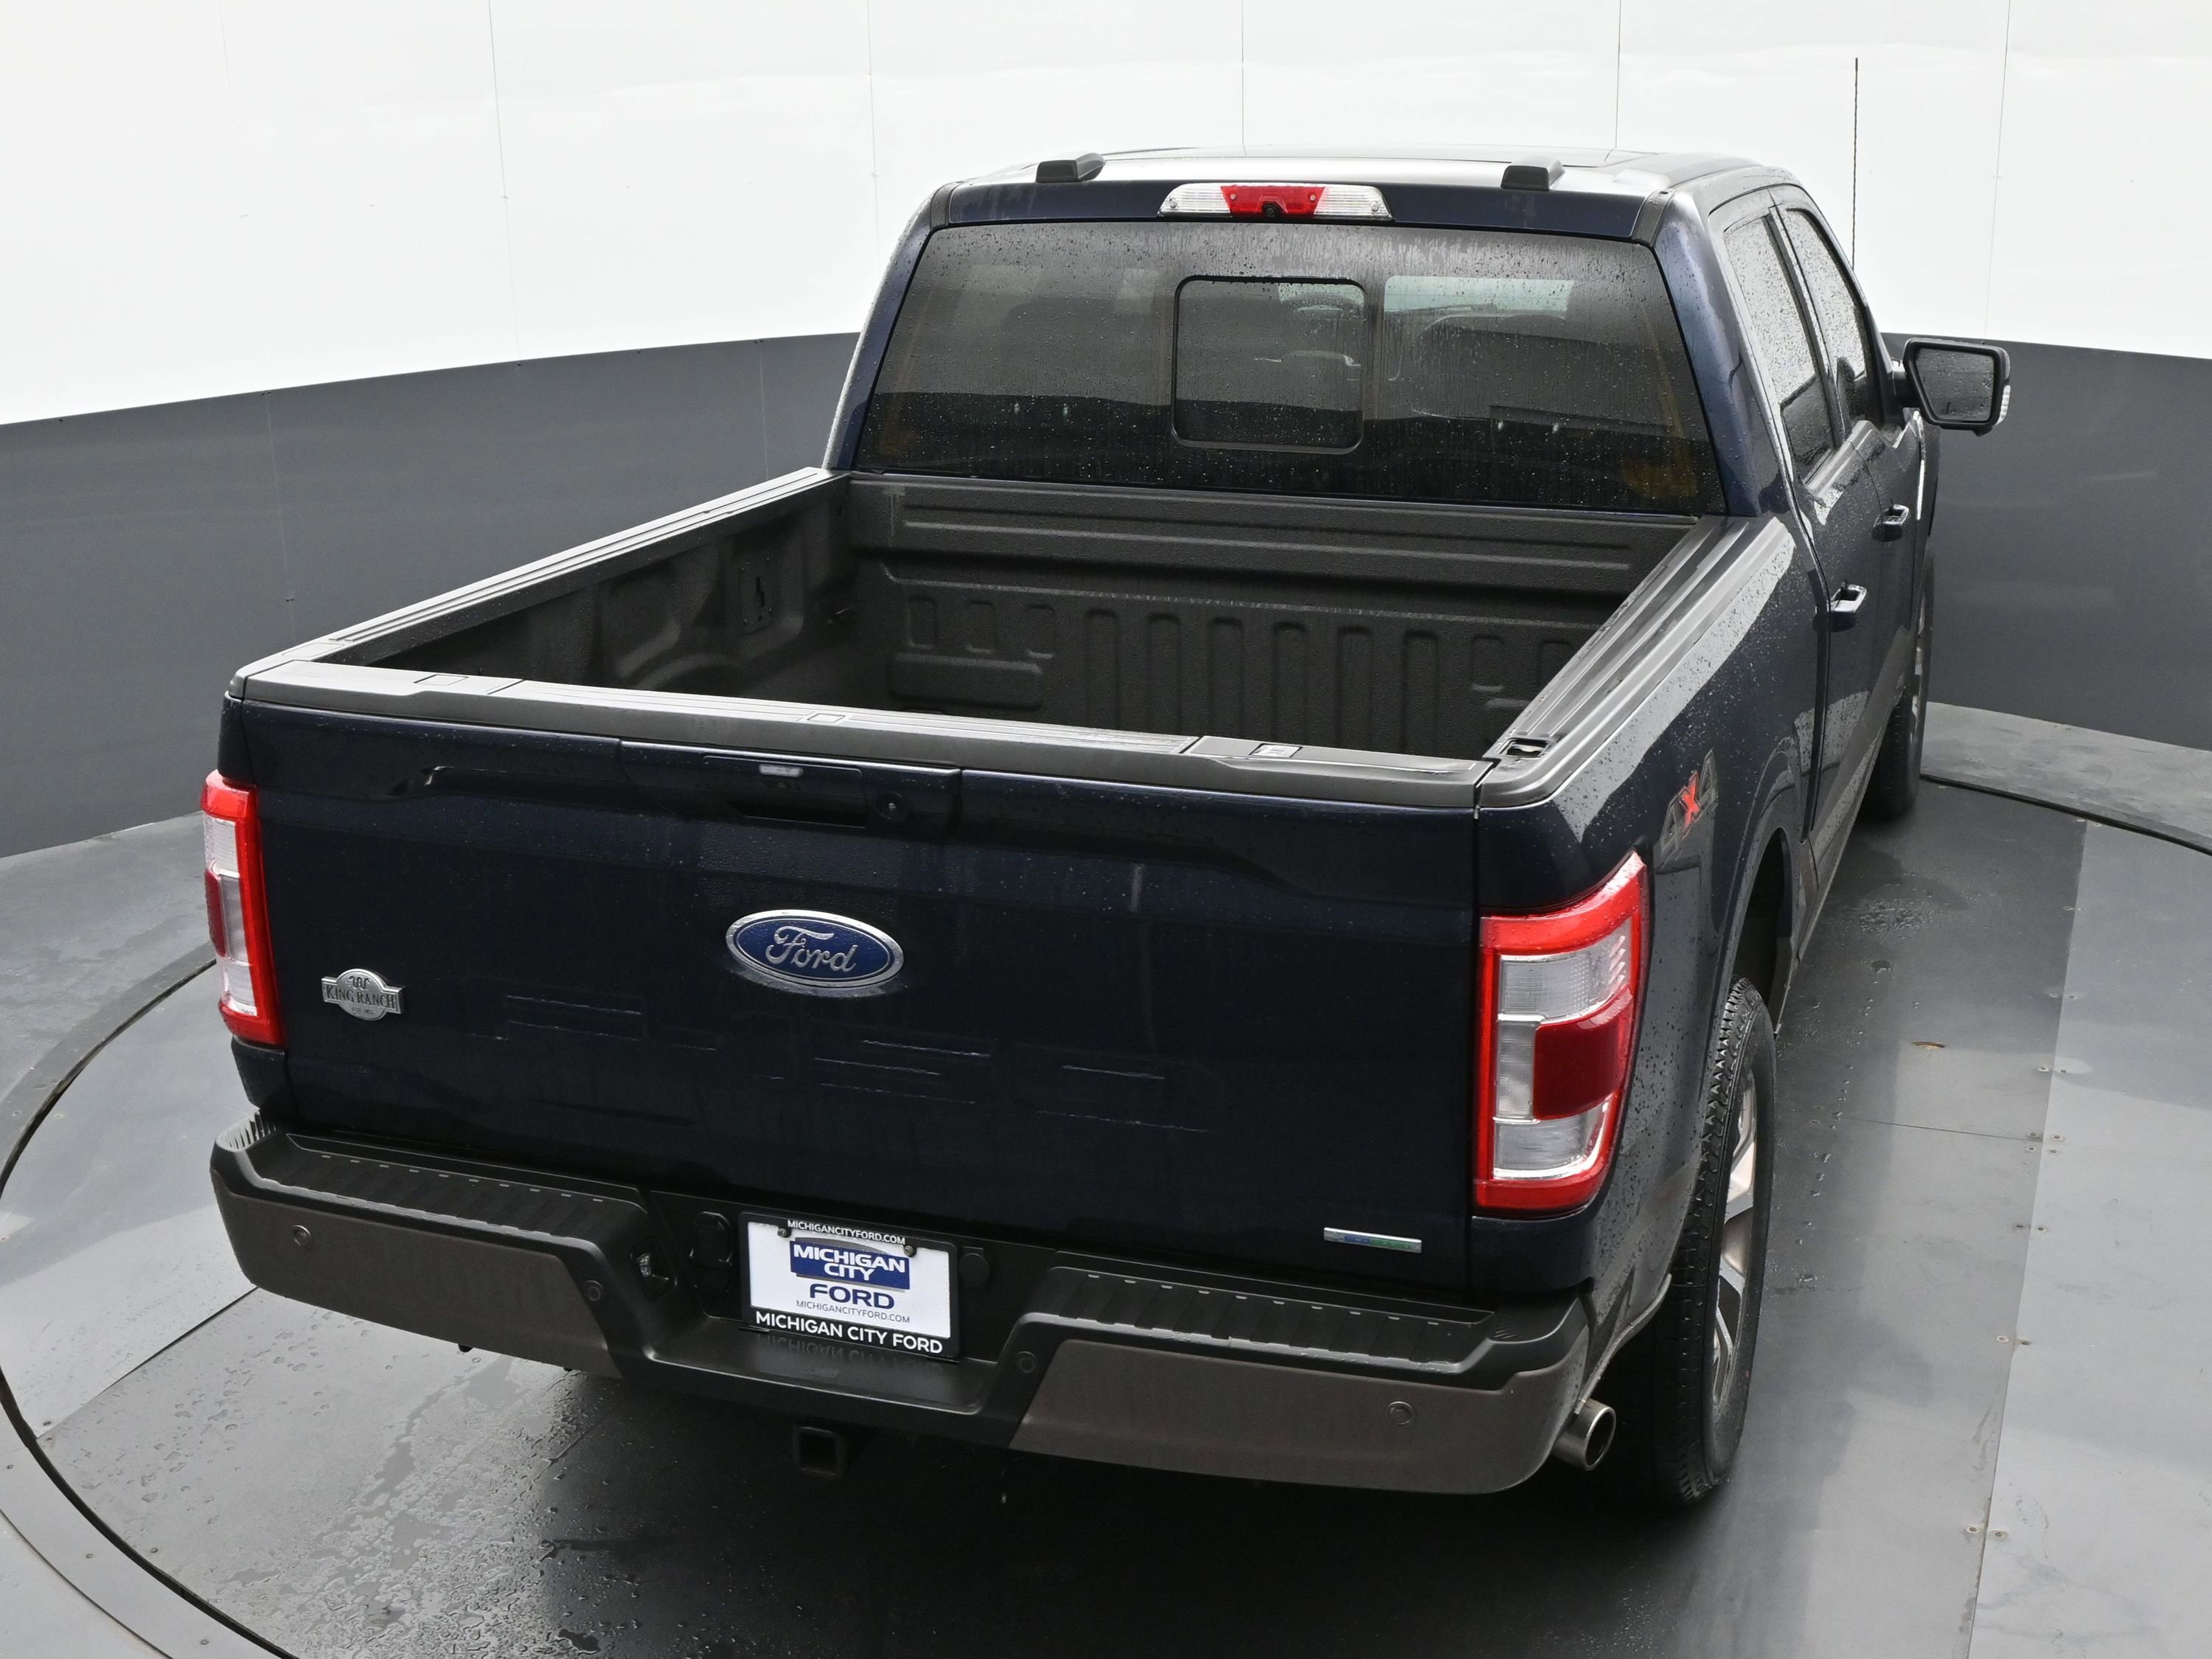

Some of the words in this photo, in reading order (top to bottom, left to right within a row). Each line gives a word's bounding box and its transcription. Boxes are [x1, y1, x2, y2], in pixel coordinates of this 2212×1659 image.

[765, 925, 858, 973] Ford
[326, 984, 354, 1003] KING
[357, 991, 397, 1009] RANCH
[787, 1220, 905, 1245] MICHIGANCITYFORD.COM
[793, 1244, 905, 1273] MICHIGAN
[824, 1263, 875, 1281] CITY
[810, 1283, 895, 1310] FORD
[796, 1300, 911, 1324] MICHIGANCITYFORD.COM
[756, 1311, 843, 1338] MICHIGAN
[847, 1326, 888, 1345] CITY
[892, 1334, 943, 1354] FORD
